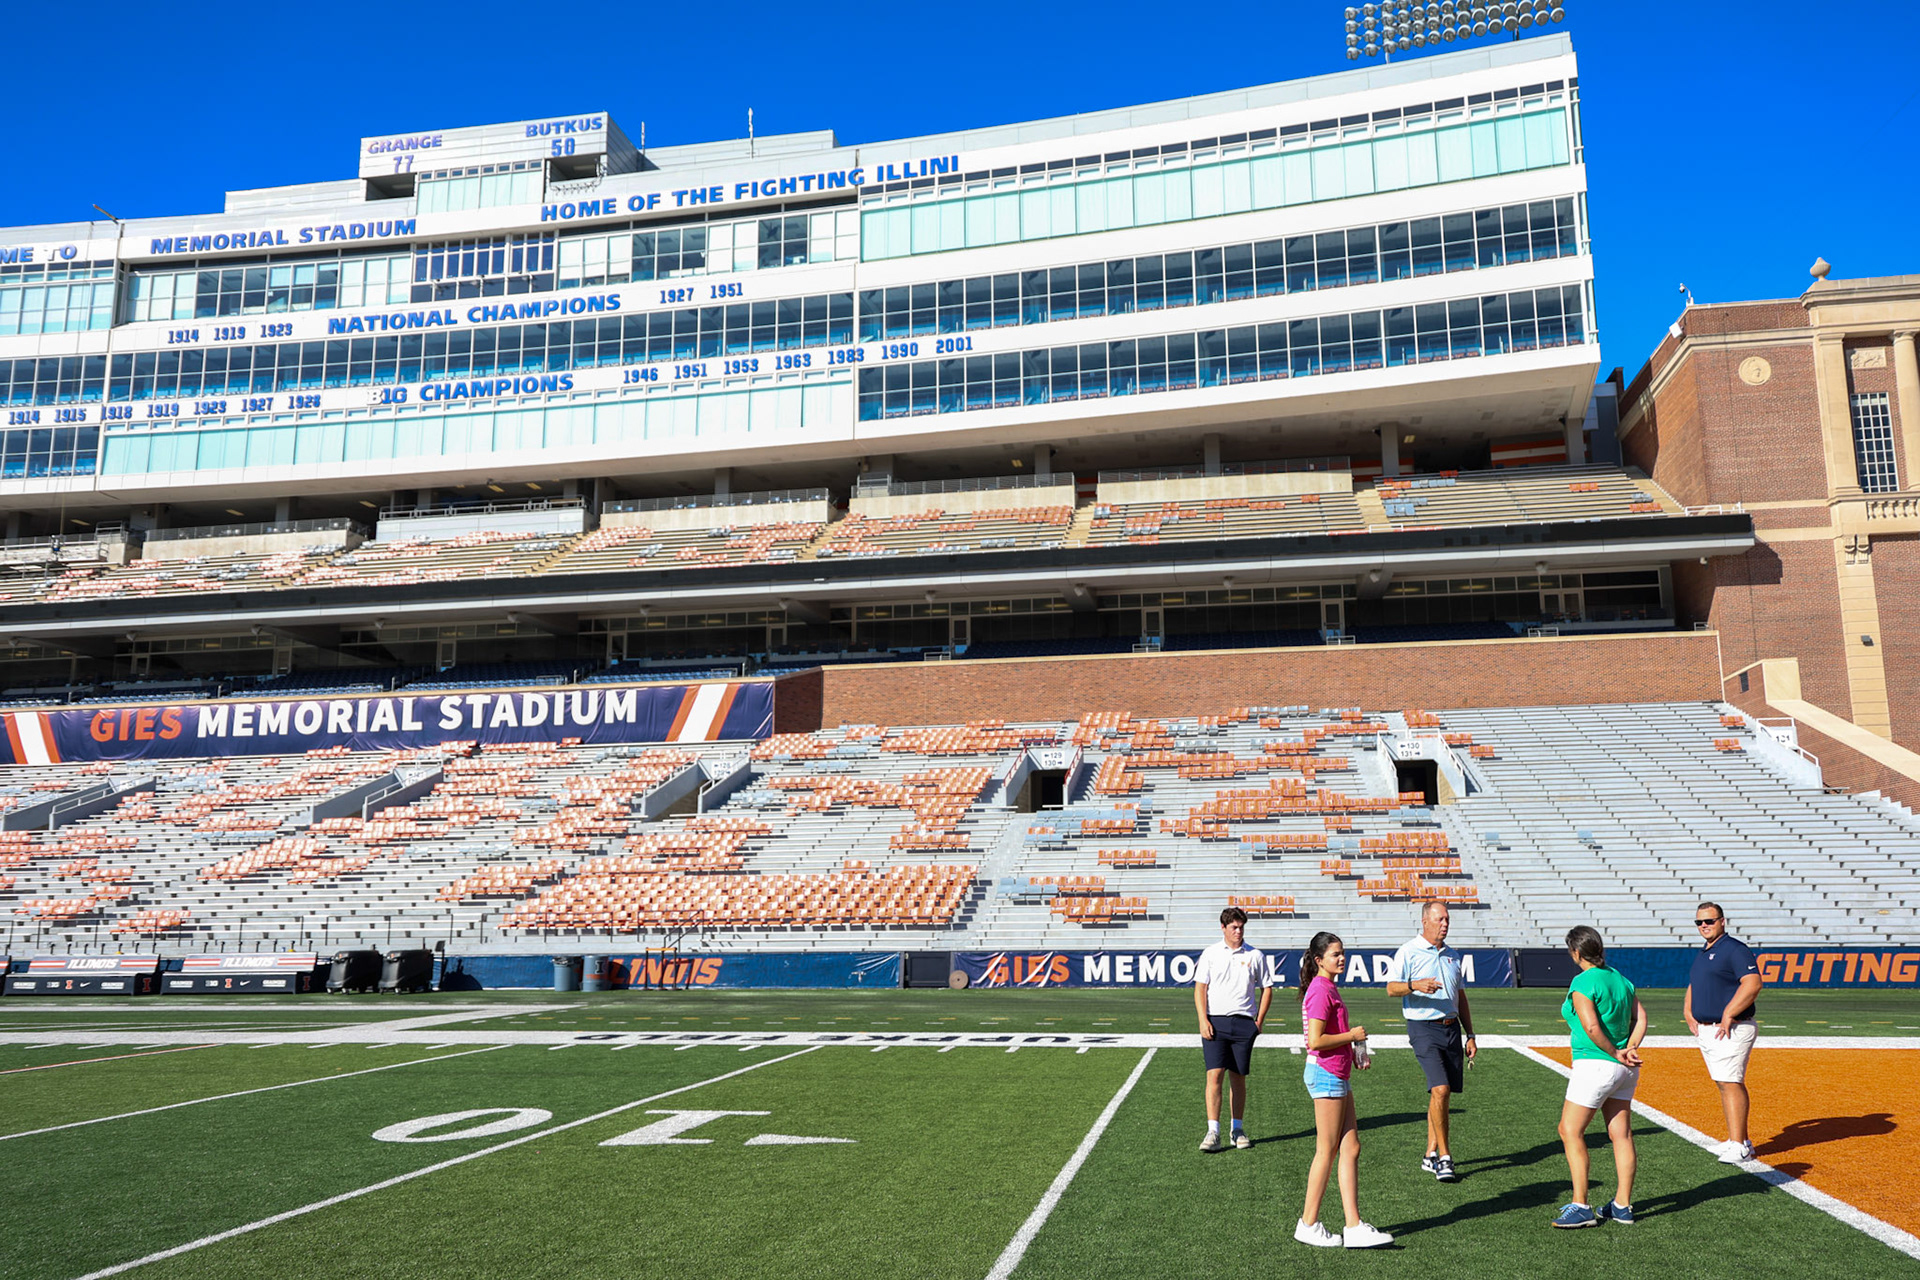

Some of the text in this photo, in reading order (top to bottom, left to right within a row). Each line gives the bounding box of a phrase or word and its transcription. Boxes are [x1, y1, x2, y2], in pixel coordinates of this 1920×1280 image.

[525, 116, 603, 138] BUTKUS
[367, 134, 443, 154] GRANGE
[551, 137, 576, 157] 50
[393, 154, 415, 174] 77
[541, 155, 959, 222] HOME OF THE FIGHTING ILLINI
[0, 247, 34, 265] ME
[150, 229, 289, 254] MEMORIAL
[299, 218, 417, 244] STADIUM
[167, 282, 744, 344] 1914 1919 1923 NATIONAL CHAMPIONS 1927 1951
[8, 410, 41, 425] 1914
[54, 407, 87, 423] 1915
[101, 405, 133, 421] 1918
[147, 402, 180, 418] 1919
[193, 400, 228, 416] 1923
[241, 397, 274, 413] 1927
[288, 394, 322, 410] 1928
[419, 373, 574, 402] CHAMPIONS
[623, 368, 659, 384] 1946
[674, 363, 708, 380] 1951
[724, 358, 759, 375] 1953
[775, 352, 812, 370] 1963
[828, 347, 865, 365] 1983
[882, 342, 919, 360] 1990
[936, 336, 974, 354] 2001
[89, 689, 638, 743] GIES MEMORIAL STADIUM
[222, 957, 277, 968] ILLINOIS
[987, 954, 1070, 983] GIES
[1083, 954, 1286, 983] MEMOL
[1754, 952, 1920, 983] GHTING
[807, 1034, 1124, 1044] ZUPPKE
